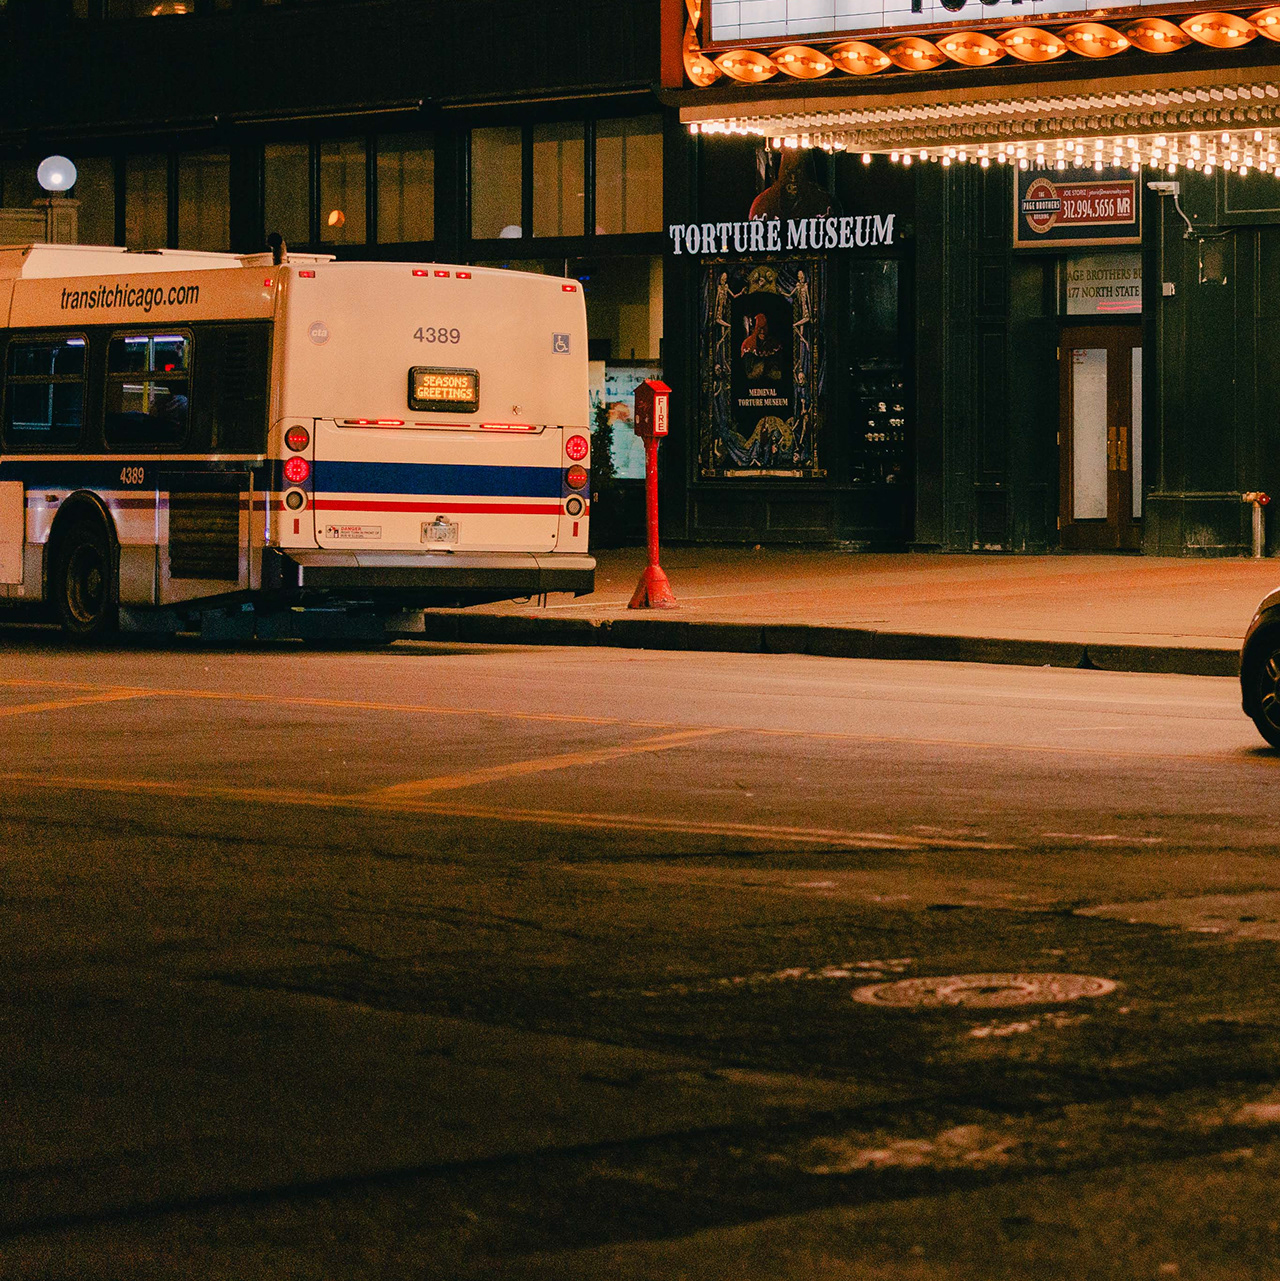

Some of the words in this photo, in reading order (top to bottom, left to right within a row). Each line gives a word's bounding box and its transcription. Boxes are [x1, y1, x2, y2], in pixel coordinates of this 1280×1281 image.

[1036, 201, 1060, 210] BROTHERS
[1063, 199, 1114, 218] 312.994.5656
[1117, 198, 1130, 213] MR
[669, 220, 782, 255] TORTURE
[785, 213, 896, 250] MUSEUM
[1086, 268, 1131, 280] BROTHERS
[61, 283, 199, 312] transitchicago.com
[1068, 287, 1080, 298] 177
[1082, 285, 1112, 298] NORTH
[1115, 285, 1139, 298] STATE
[311, 329, 328, 337] cta
[413, 327, 461, 344] 4389
[423, 376, 468, 388] SEASONS
[417, 387, 473, 399] GREETINGS
[748, 388, 777, 397] MEDIEVAL
[738, 398, 763, 407] TORTURE
[763, 397, 788, 406] MUSEUM
[120, 466, 145, 484] 4389
